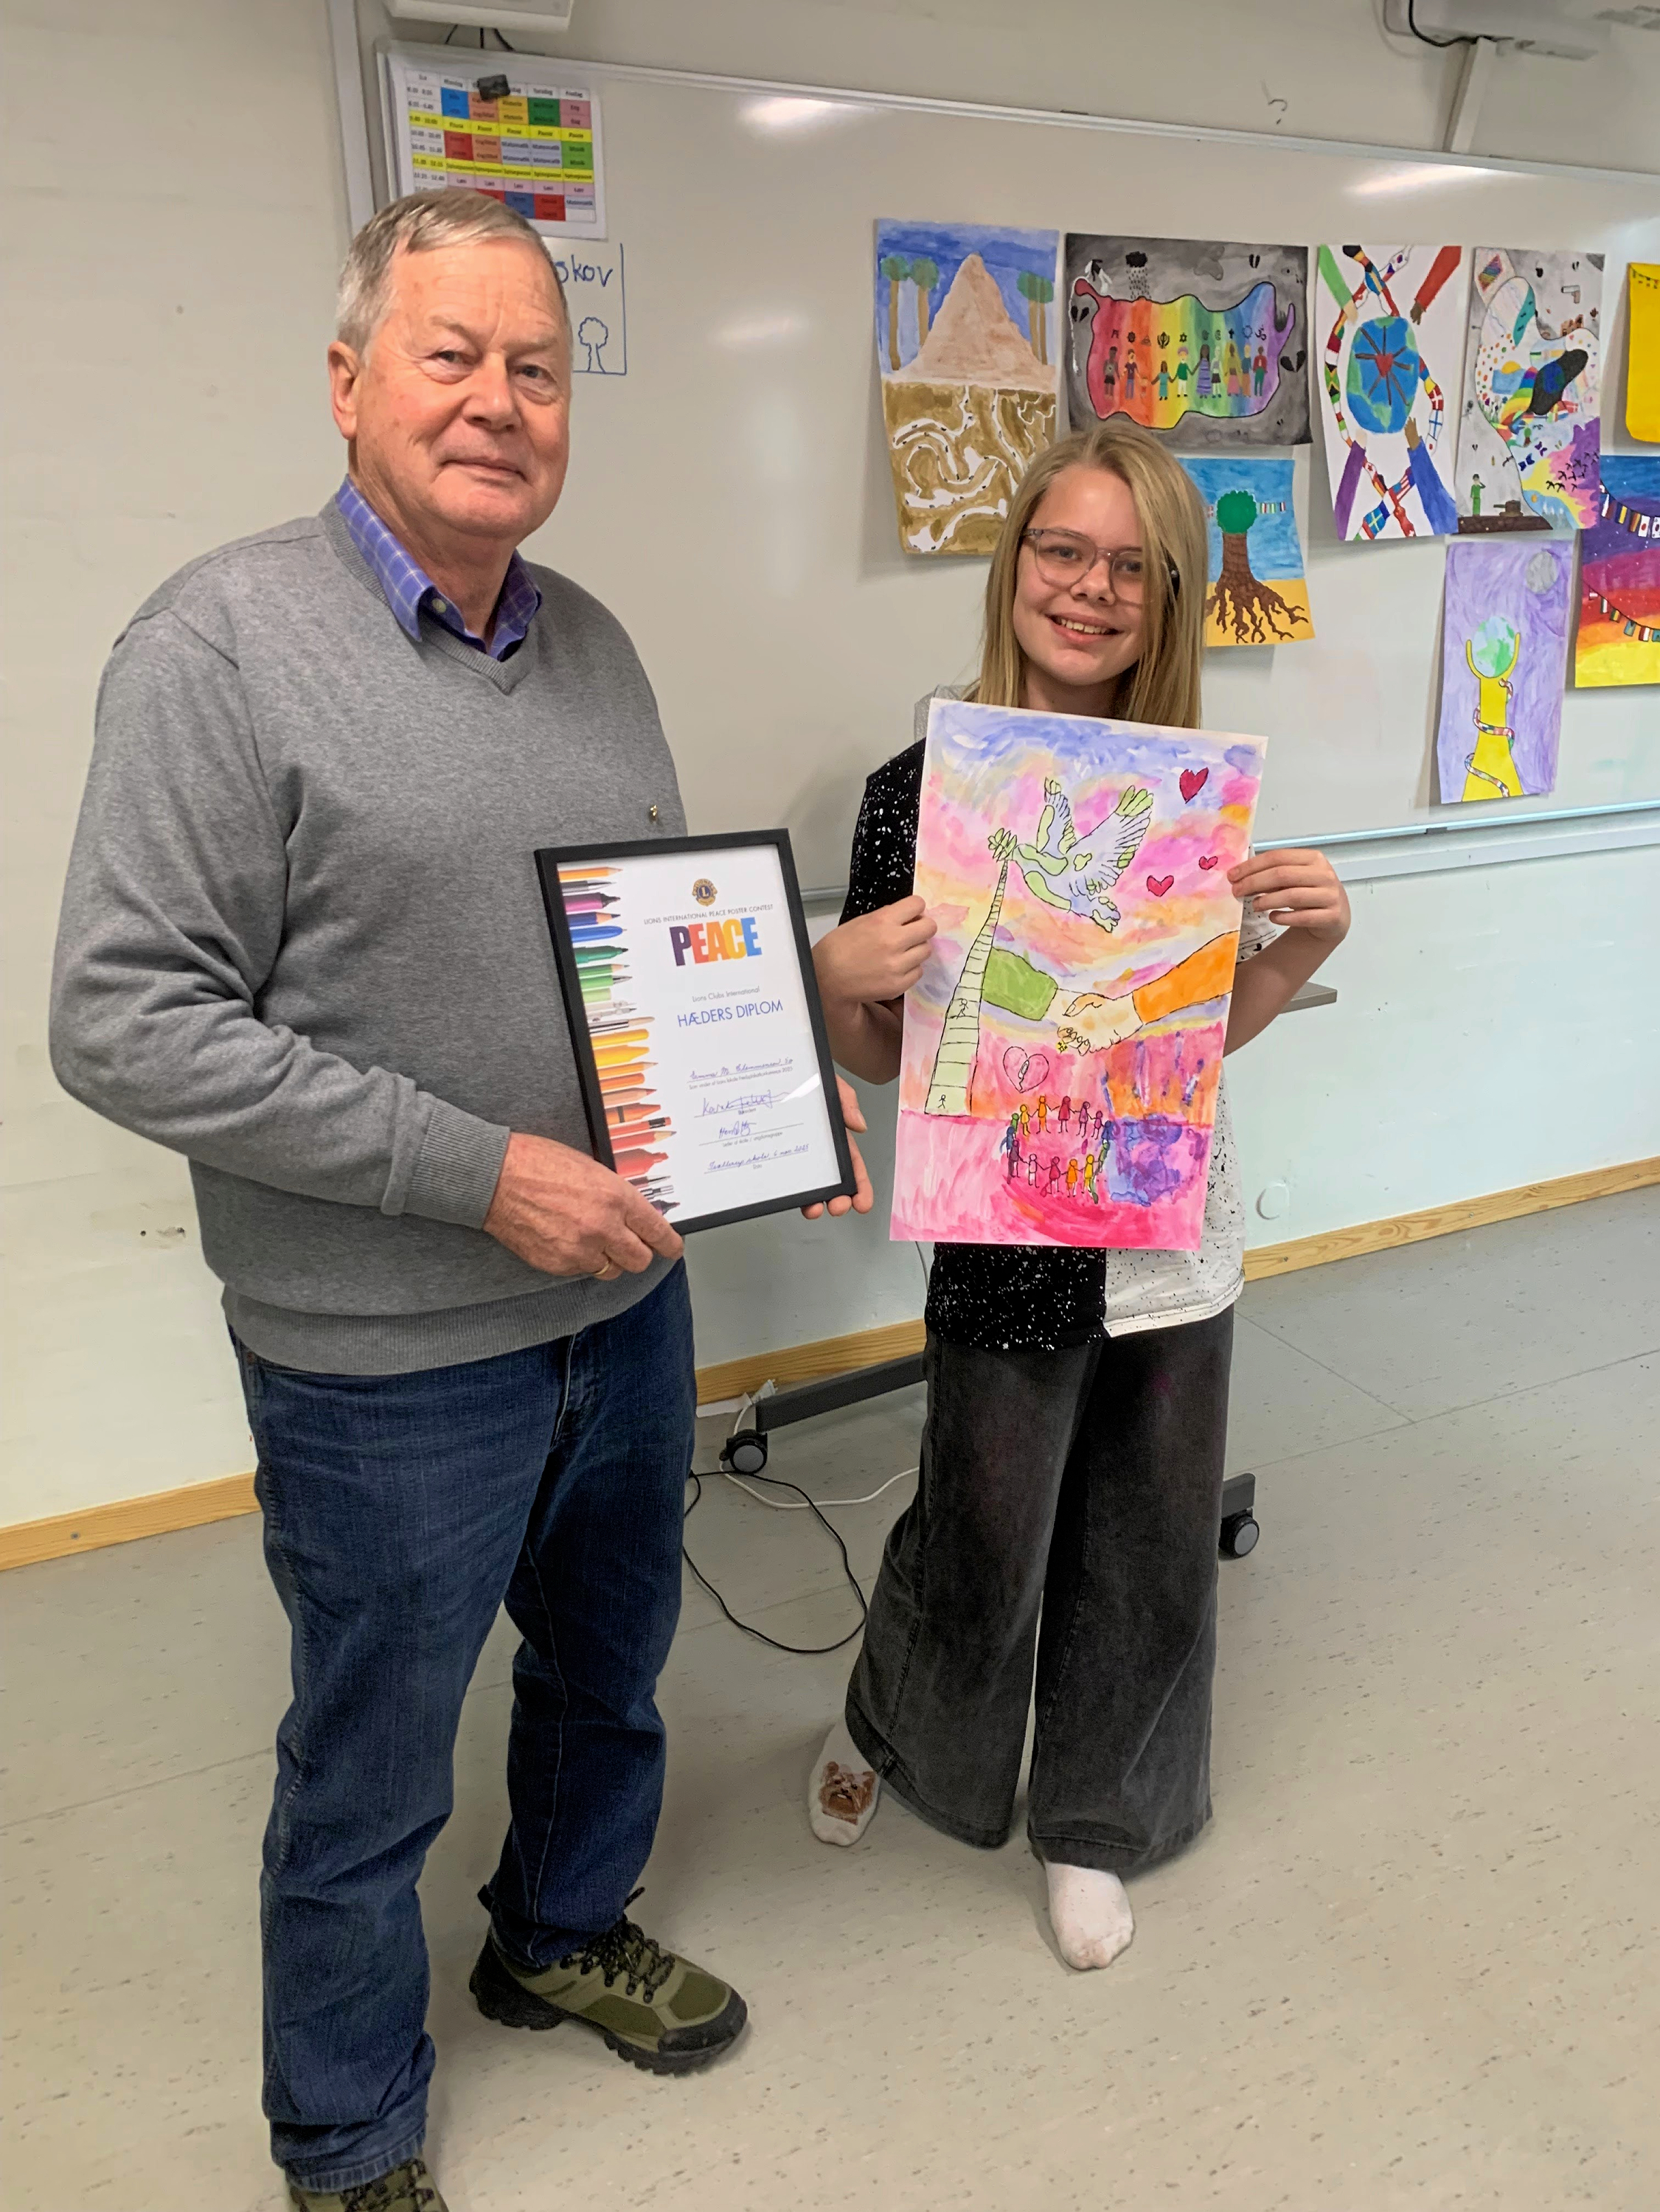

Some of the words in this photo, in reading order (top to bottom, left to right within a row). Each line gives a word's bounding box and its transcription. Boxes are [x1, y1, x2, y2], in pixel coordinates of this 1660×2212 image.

[664, 912, 707, 922] INTERNATIONAL
[749, 904, 774, 912] CONTEST
[669, 917, 762, 967] PEACE
[692, 994, 706, 1002] Lions
[708, 992, 724, 1001] Clubs
[726, 986, 760, 998] International
[677, 1008, 733, 1027] HÆDERS
[737, 999, 782, 1018] DIPLOM
